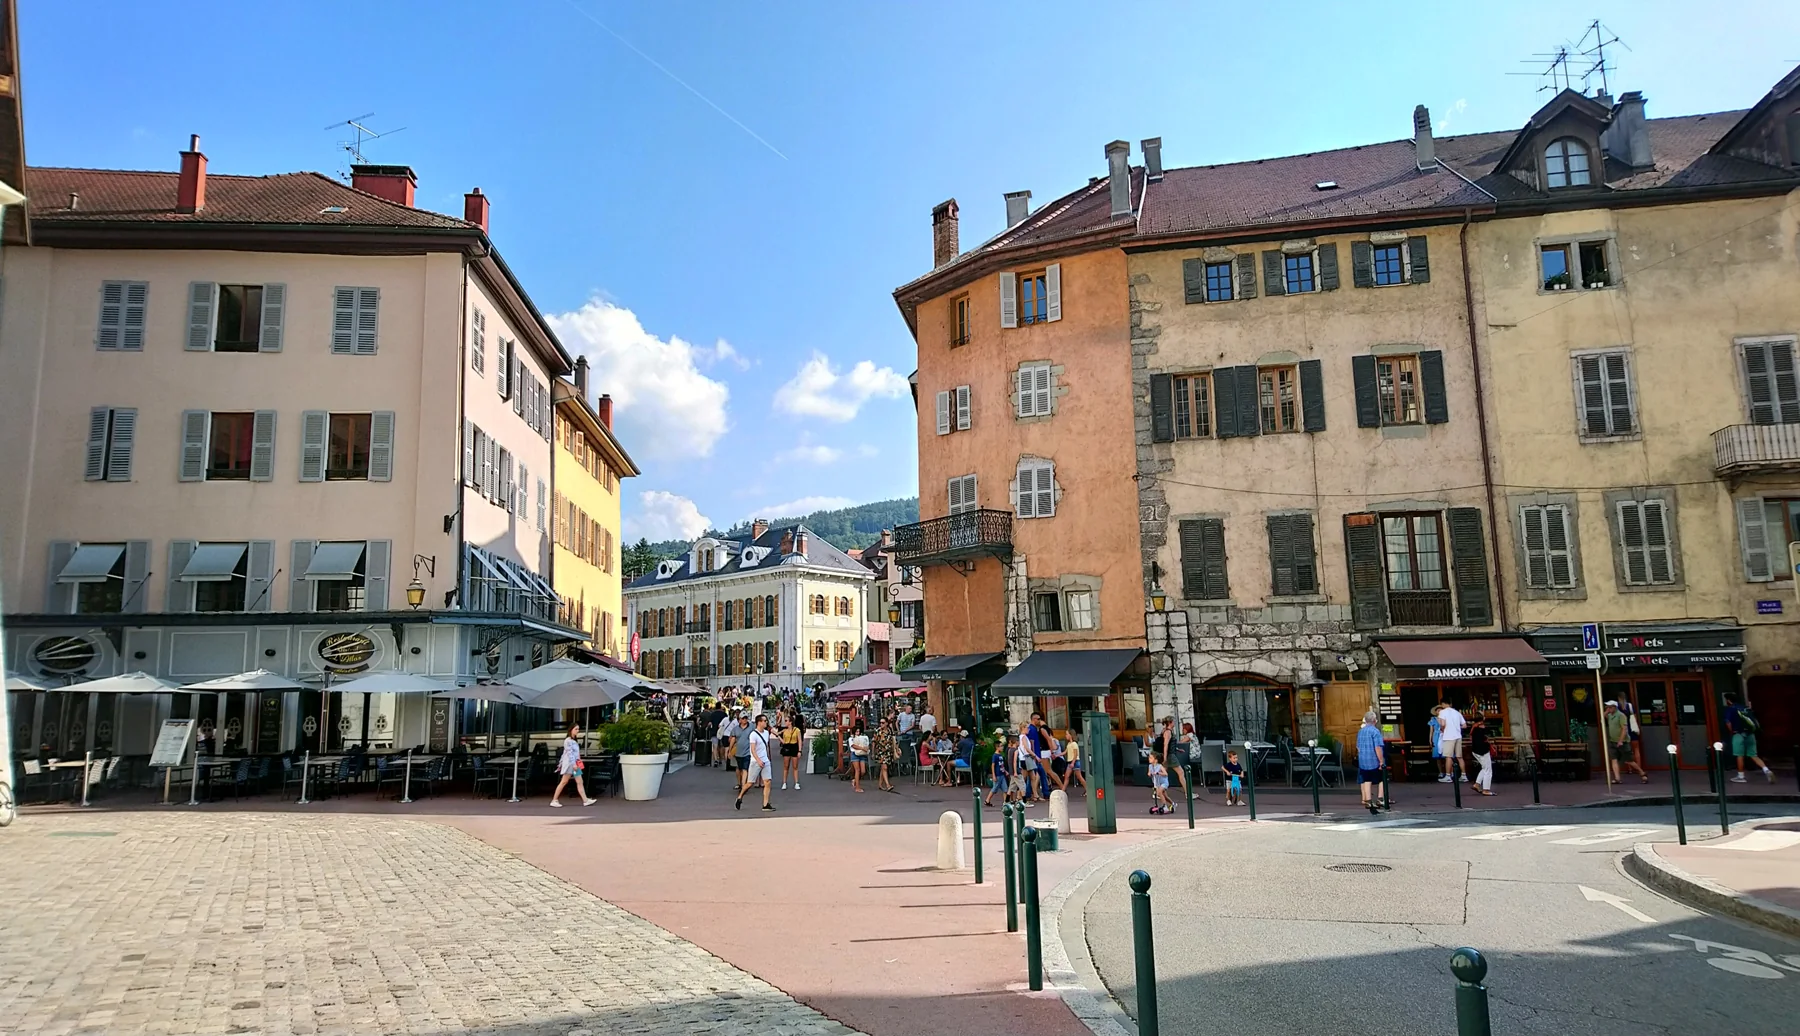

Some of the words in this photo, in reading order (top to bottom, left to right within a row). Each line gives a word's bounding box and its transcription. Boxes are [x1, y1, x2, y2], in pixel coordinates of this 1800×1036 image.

[1613, 638, 1628, 648] 1er
[1632, 637, 1664, 648] Mets
[1620, 656, 1635, 665] 1er
[1640, 656, 1669, 665] Mets
[1428, 668, 1482, 678] BANGKOK
[1485, 667, 1516, 676] FOOD
